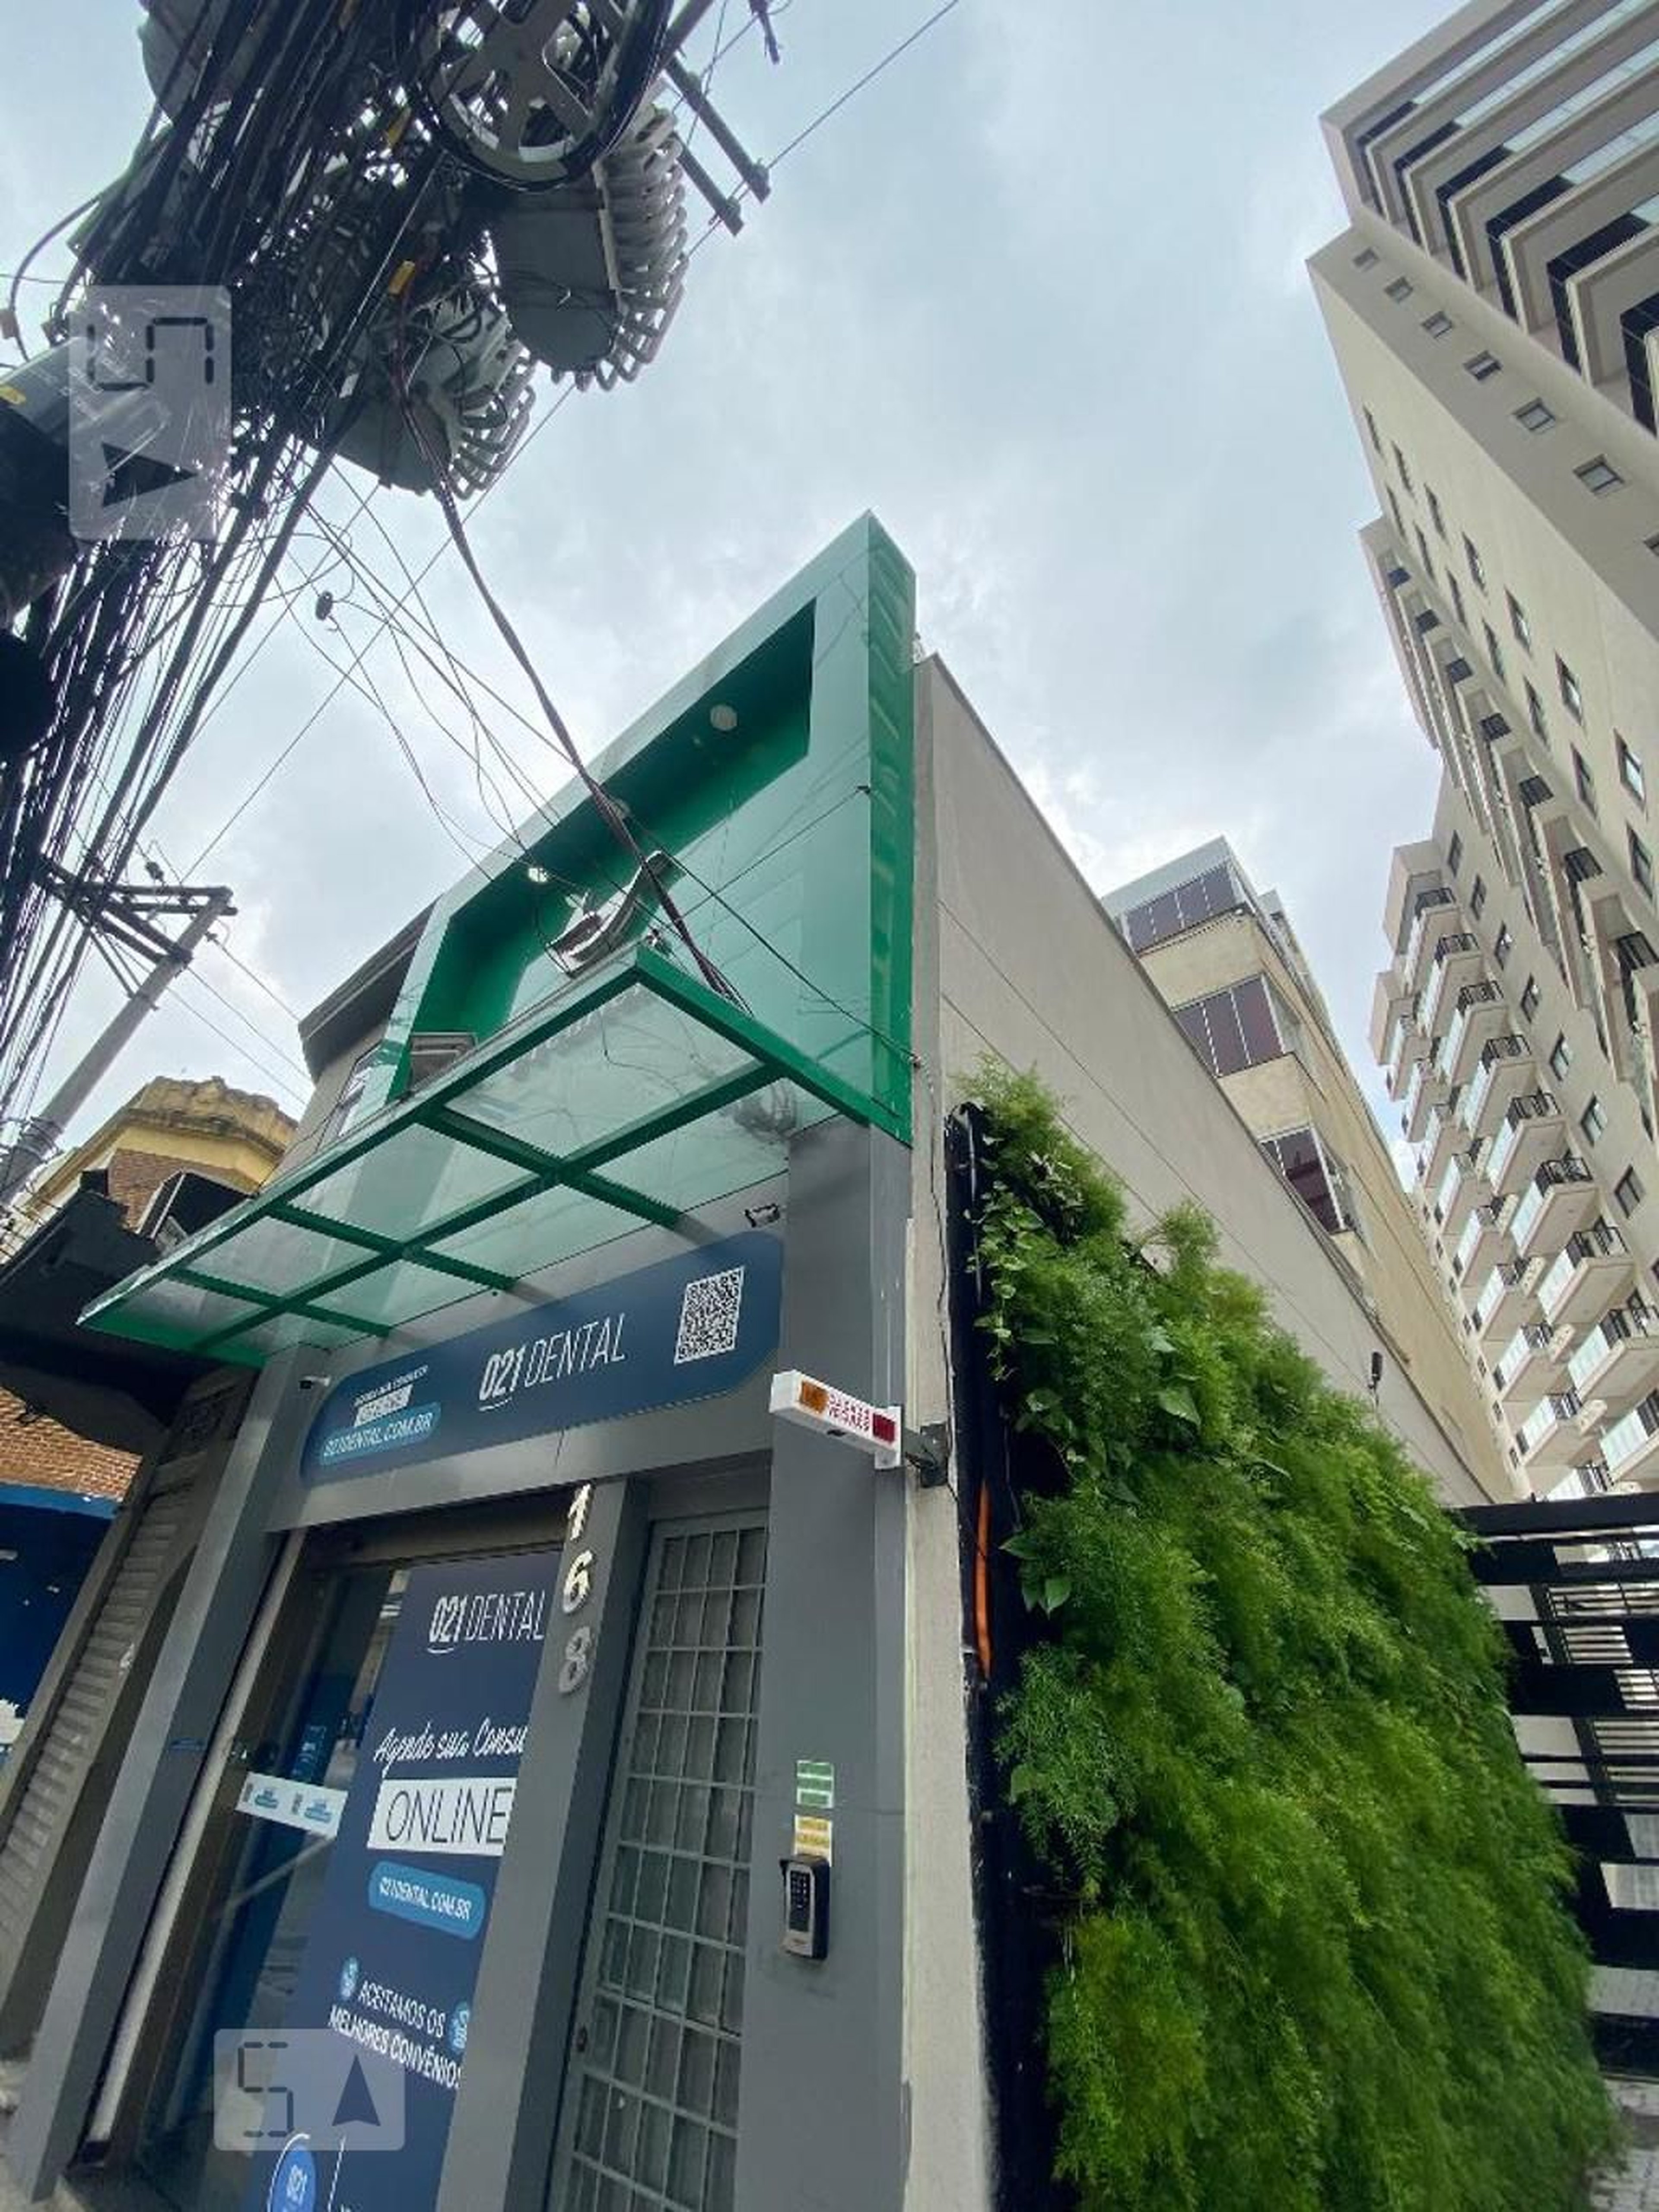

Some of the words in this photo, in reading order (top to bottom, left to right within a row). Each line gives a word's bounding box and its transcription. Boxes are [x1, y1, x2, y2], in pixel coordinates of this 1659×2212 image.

[559, 1483, 593, 1693] 168
[387, 1788, 512, 1843] ONLINE
[328, 2004, 389, 2054] MELHORES
[427, 2008, 445, 2038] OS
